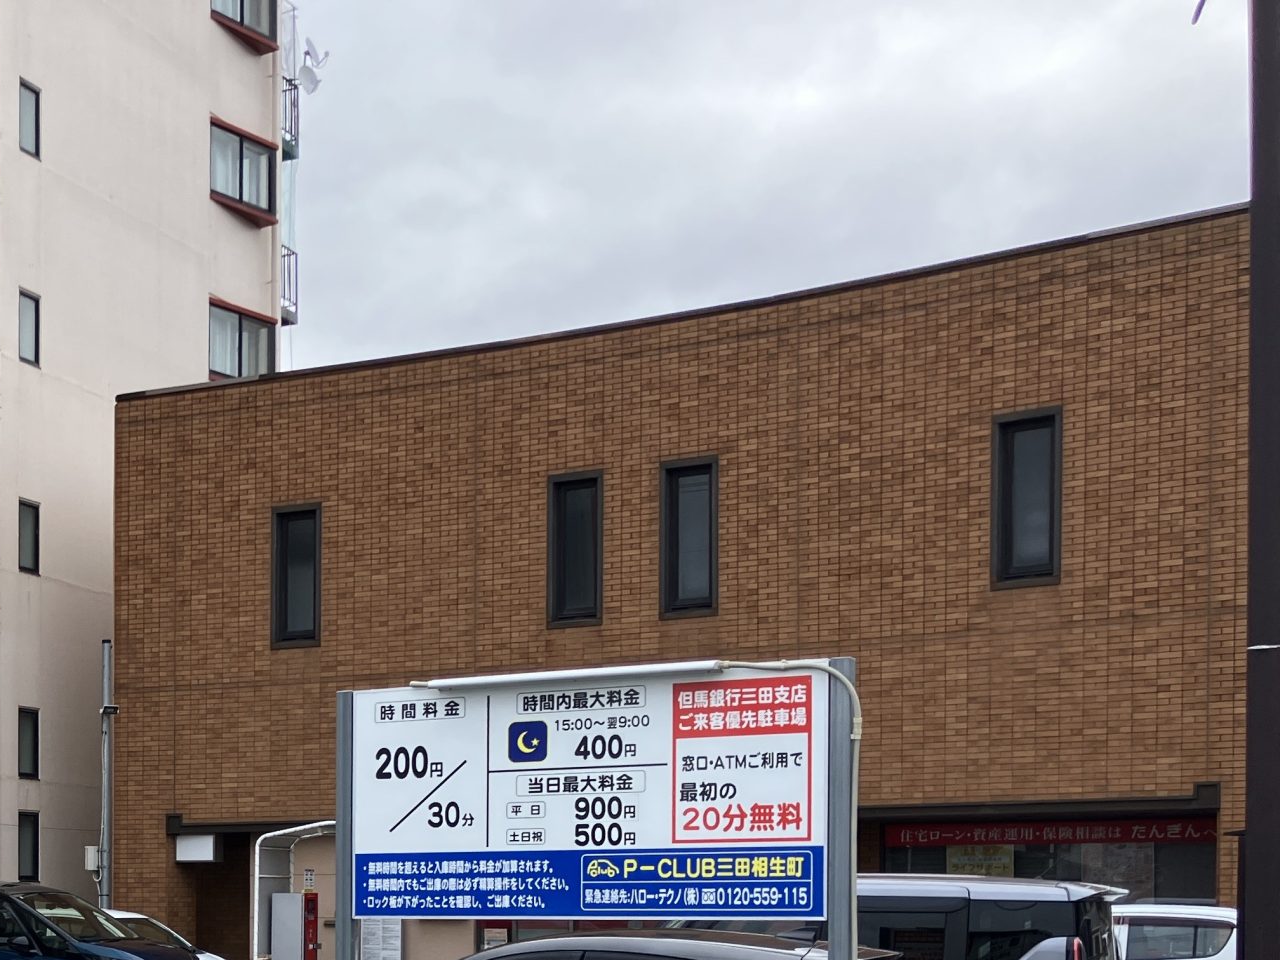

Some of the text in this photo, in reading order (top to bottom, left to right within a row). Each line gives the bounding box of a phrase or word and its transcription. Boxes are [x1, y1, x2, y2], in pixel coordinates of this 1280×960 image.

[522, 688, 640, 712] 時間内最大料金
[677, 684, 807, 710] 但馬銀行三田支店
[380, 700, 460, 720] 時間料金
[678, 707, 807, 731] ご来客優先駐車場
[574, 734, 637, 760] 400円
[375, 745, 444, 780] 200円
[528, 773, 633, 794] 当日最大料金
[679, 781, 737, 802] 最初の
[427, 801, 475, 828] 30分
[511, 804, 541, 816] 平日
[574, 796, 636, 820] 900円
[682, 802, 803, 832] 20分無料
[509, 831, 543, 843] 土日祝
[574, 822, 636, 846] 500円
